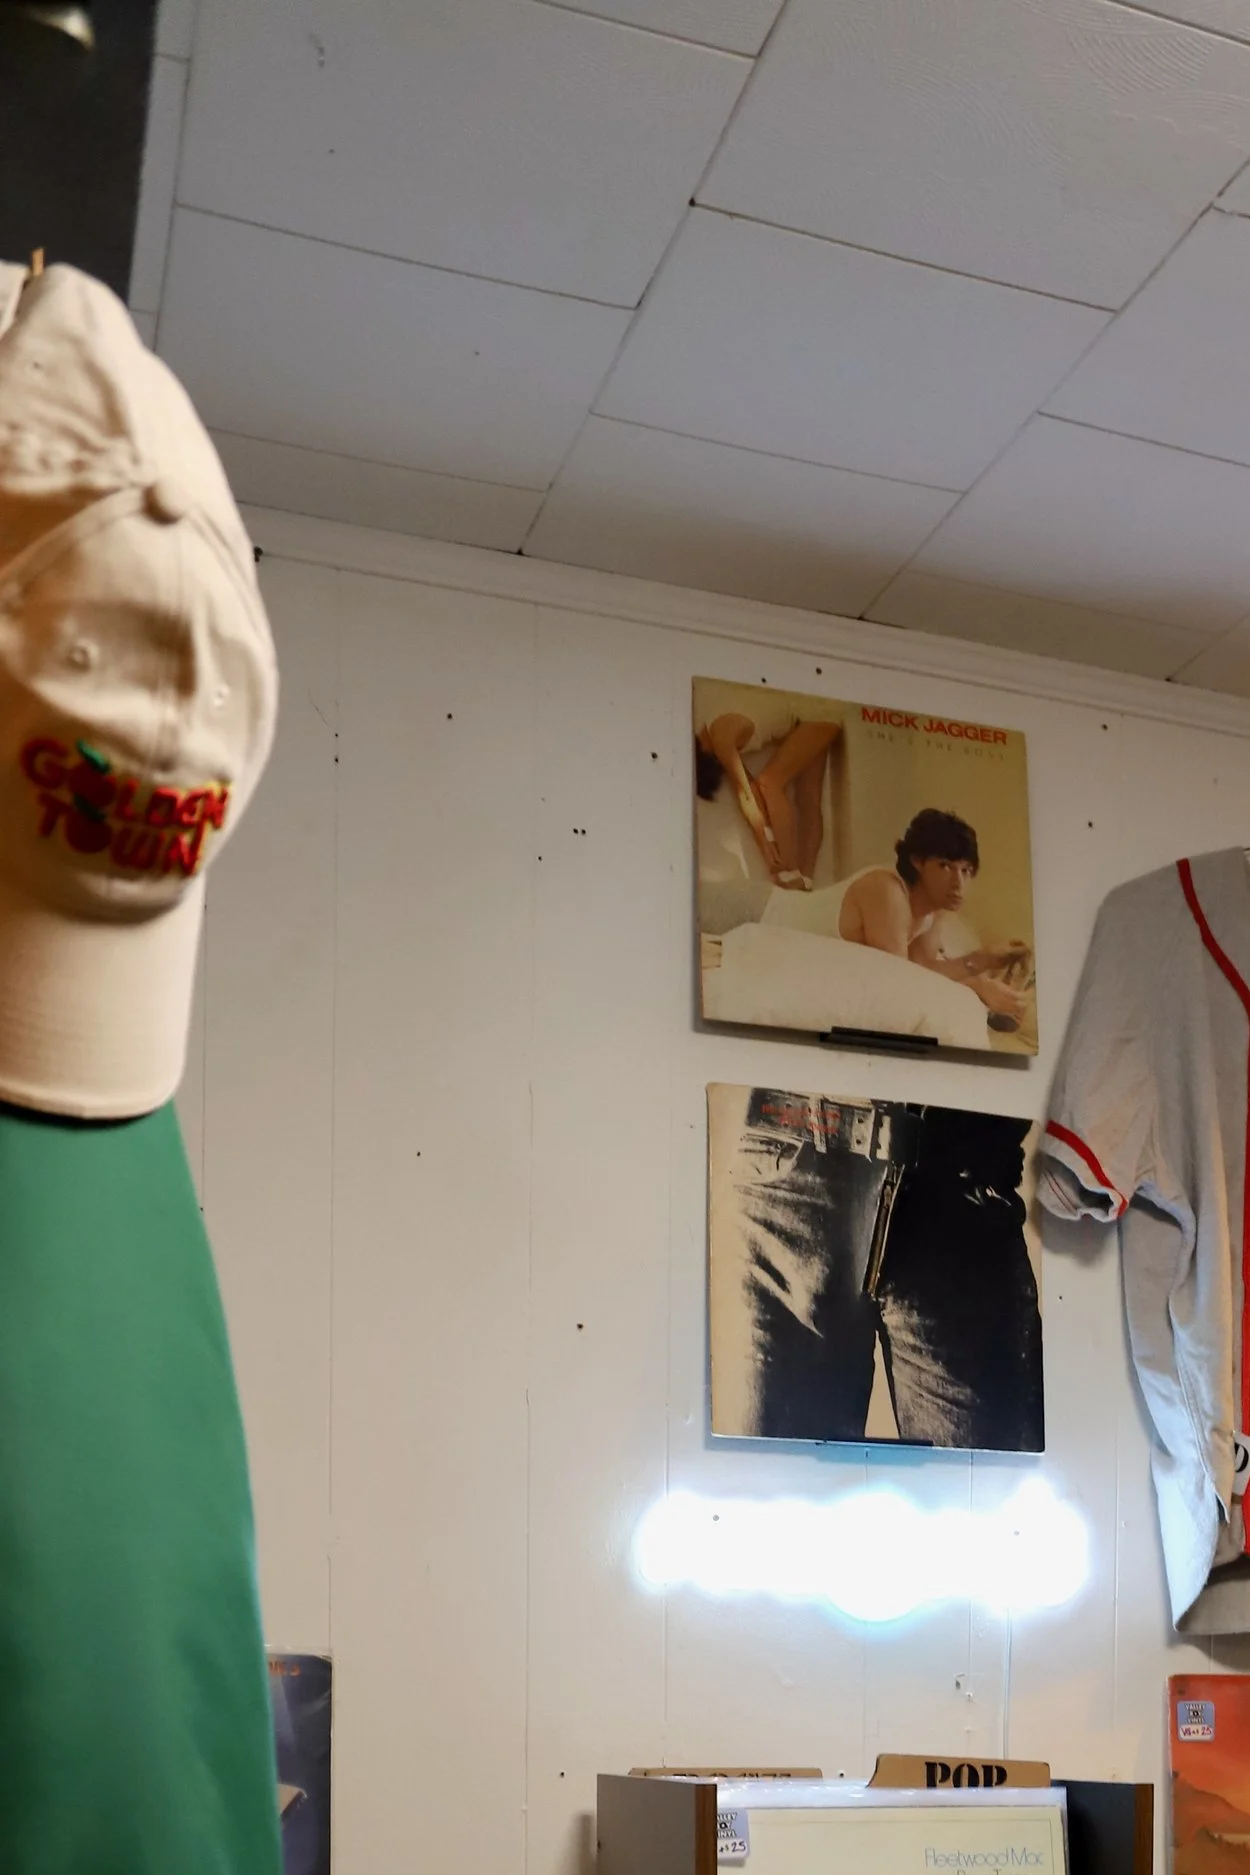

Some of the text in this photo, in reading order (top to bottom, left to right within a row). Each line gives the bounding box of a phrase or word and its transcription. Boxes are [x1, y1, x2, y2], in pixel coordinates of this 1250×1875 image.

[861, 707, 1007, 746] MICK JAGGER
[924, 1761, 1008, 1789] POP
[924, 1847, 1046, 1869] Fleetwood Mac
